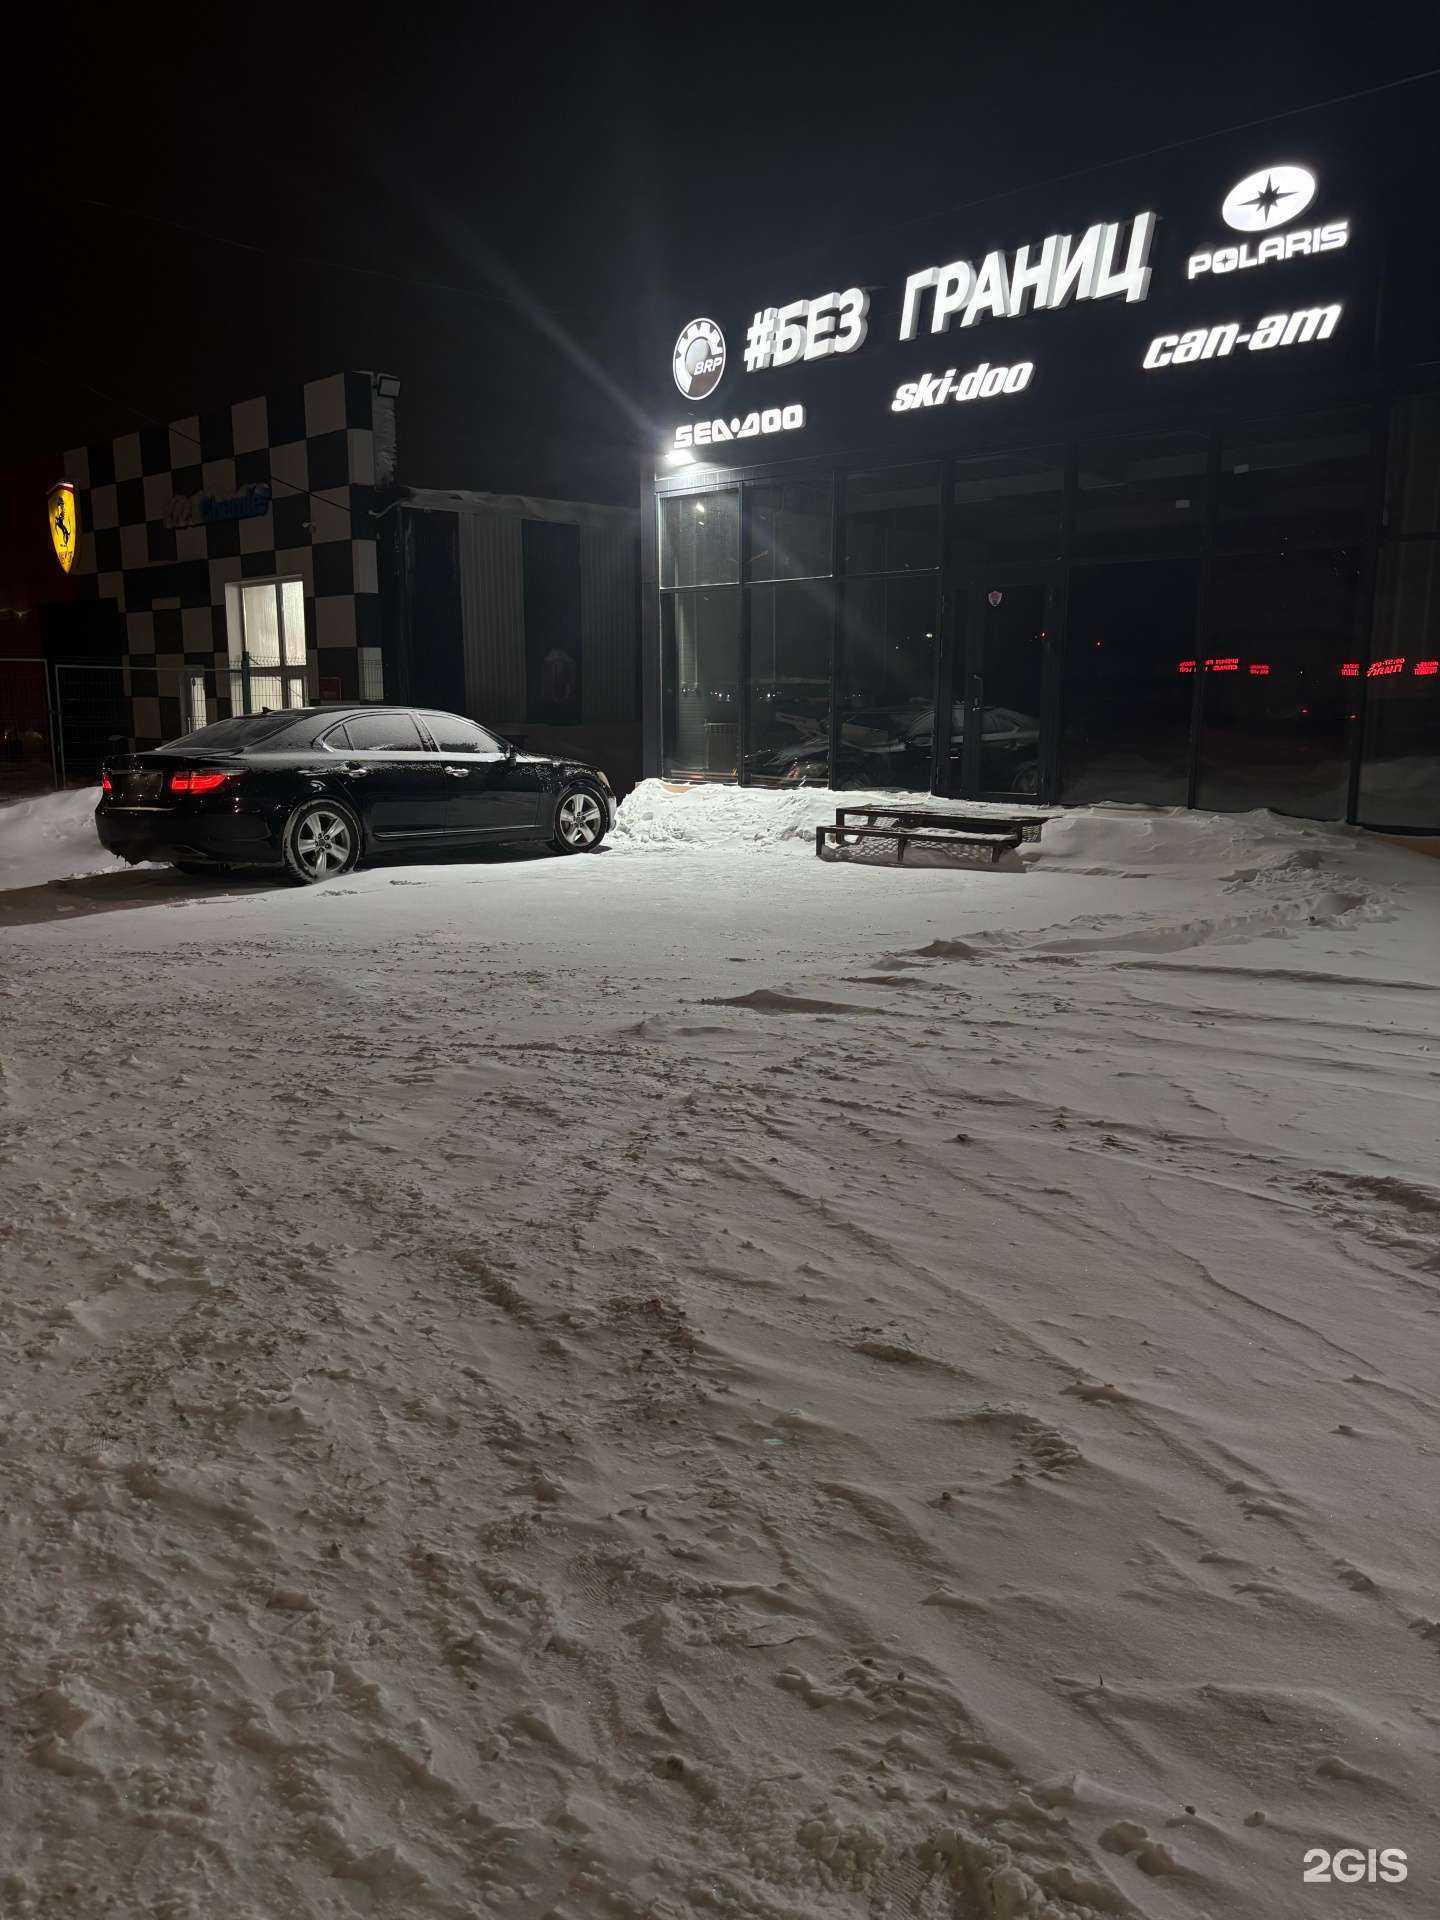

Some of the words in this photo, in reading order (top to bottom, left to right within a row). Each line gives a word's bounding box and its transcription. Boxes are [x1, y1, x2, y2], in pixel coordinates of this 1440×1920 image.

[1187, 221, 1349, 280] POLARIS
[743, 287, 871, 373] #БЕЗ
[899, 211, 1157, 342] ГРАНИЦ
[693, 356, 723, 376] BRP
[1142, 304, 1343, 370] can-am
[891, 361, 1034, 413] ski-doo
